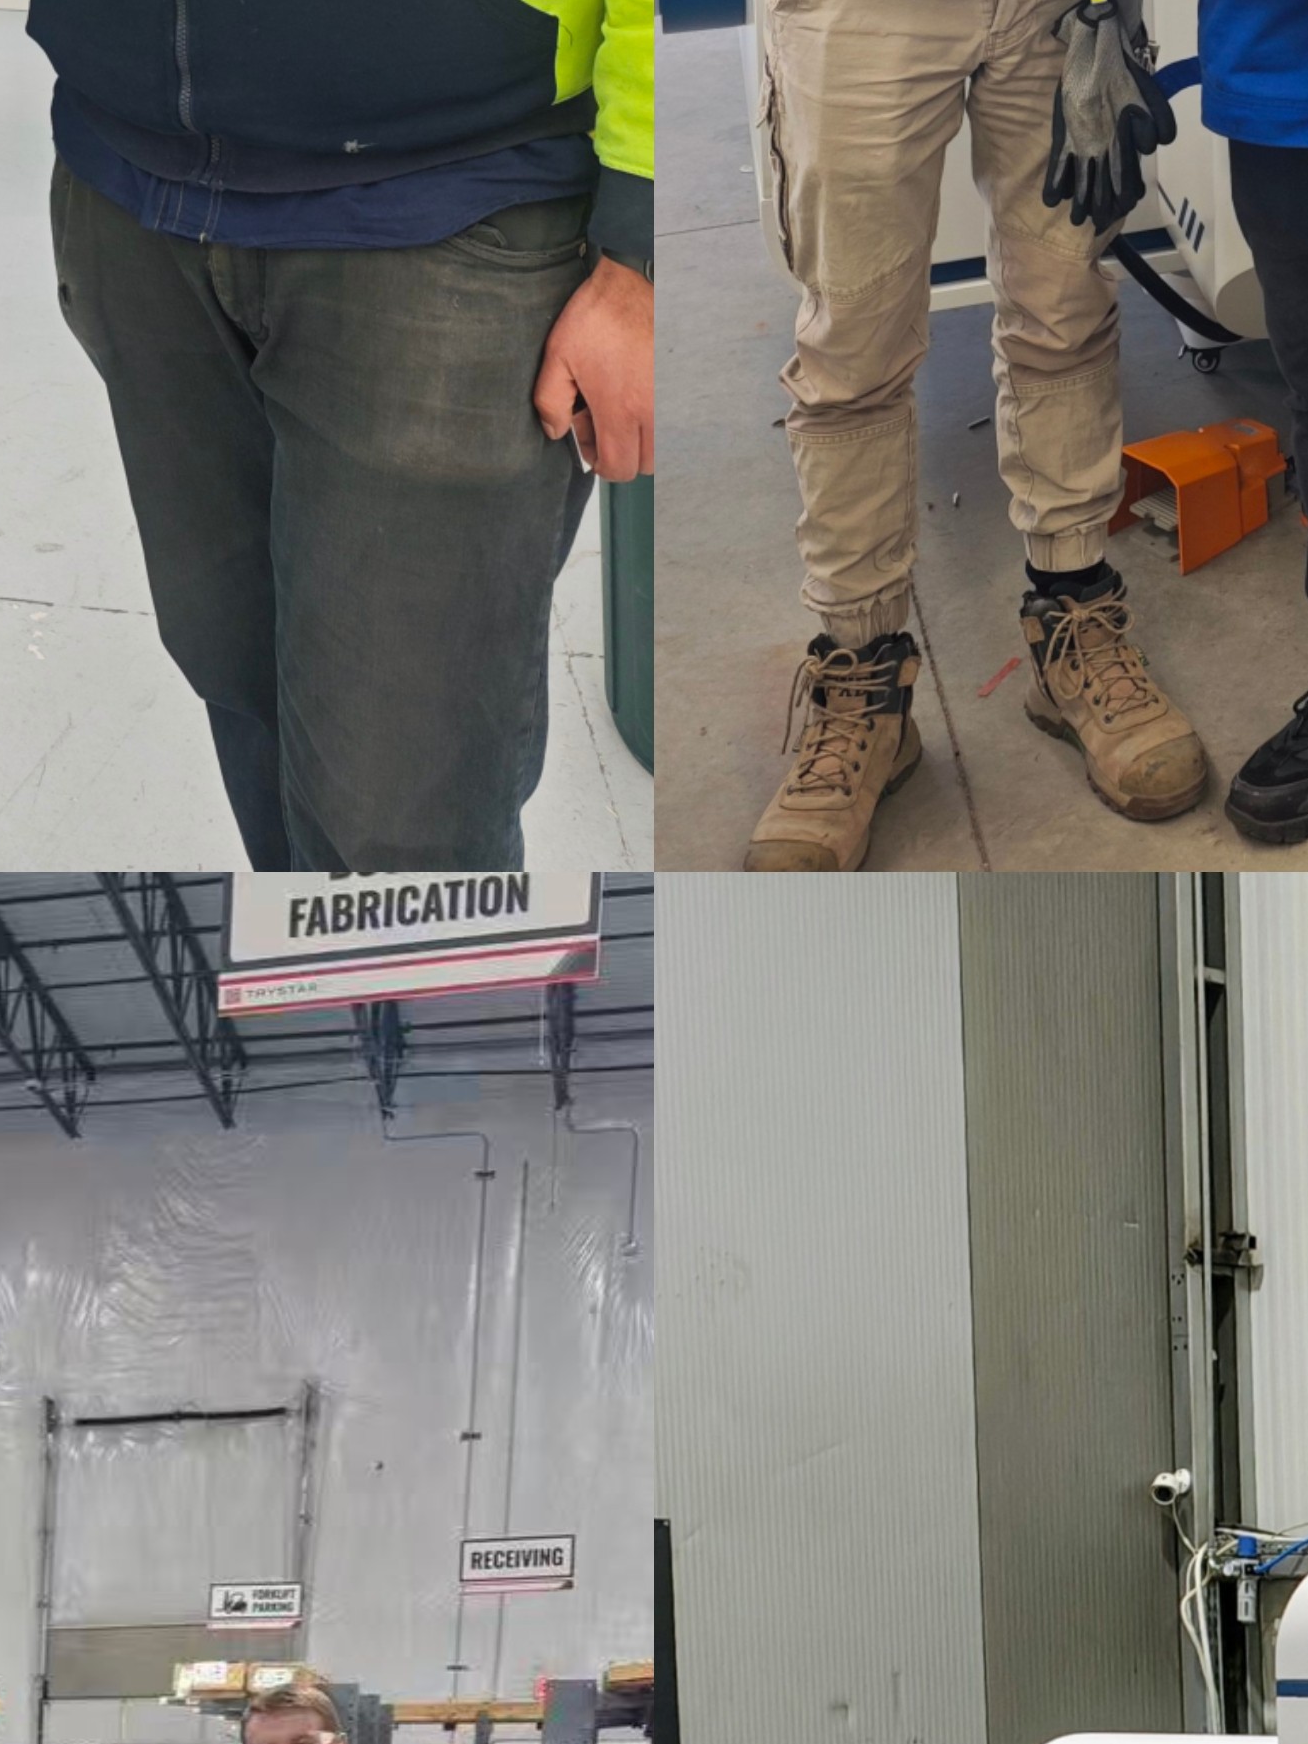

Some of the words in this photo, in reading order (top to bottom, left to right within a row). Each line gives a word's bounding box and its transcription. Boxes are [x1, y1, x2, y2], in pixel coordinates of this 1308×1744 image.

[288, 873, 530, 939] FABRICATION
[470, 1547, 565, 1570] RECEIVING
[252, 1589, 295, 1600] FORKLIFT
[252, 1602, 294, 1613] PARKING
